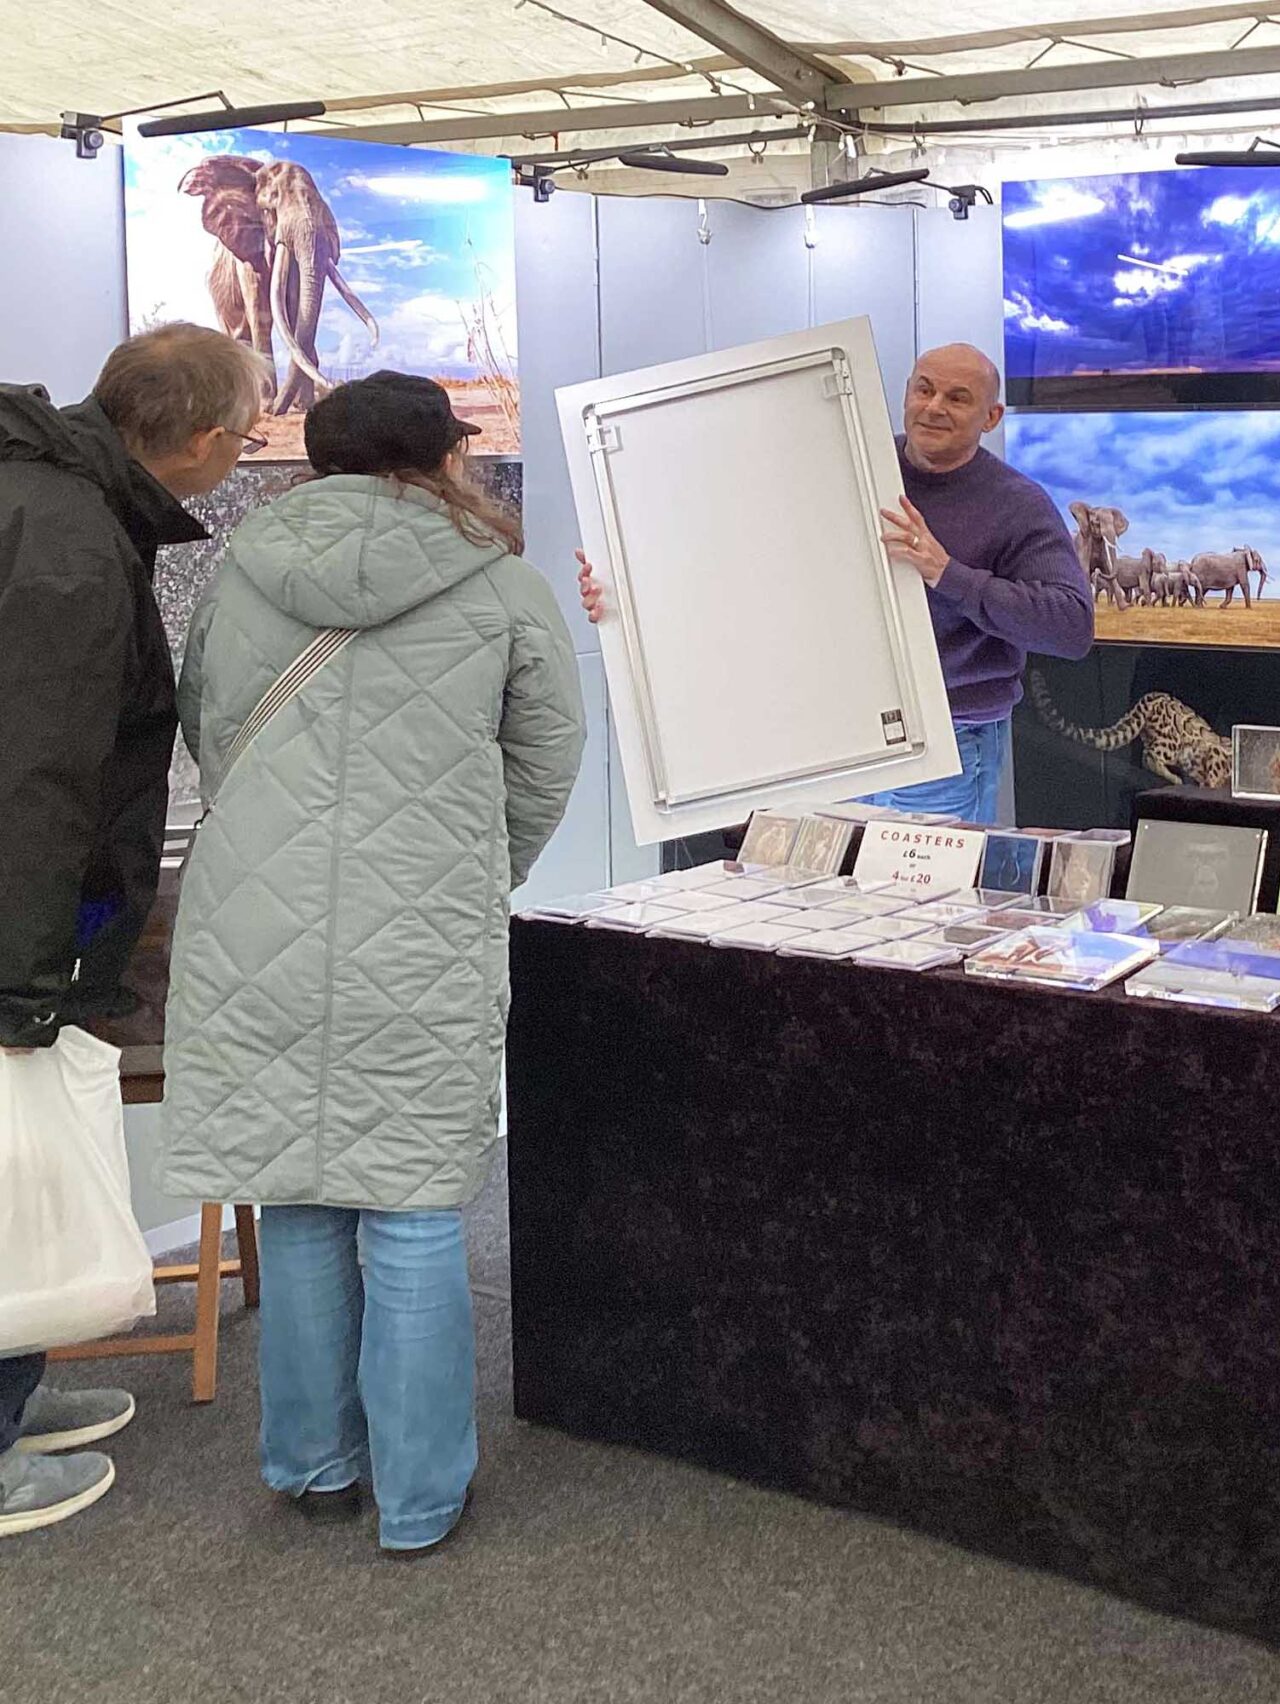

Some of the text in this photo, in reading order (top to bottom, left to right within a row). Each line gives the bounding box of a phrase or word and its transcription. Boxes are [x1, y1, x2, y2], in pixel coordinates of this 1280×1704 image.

[881, 830, 965, 848] COASTERS
[903, 849, 916, 858] £6
[892, 870, 899, 880] 4
[910, 873, 931, 884] £20
